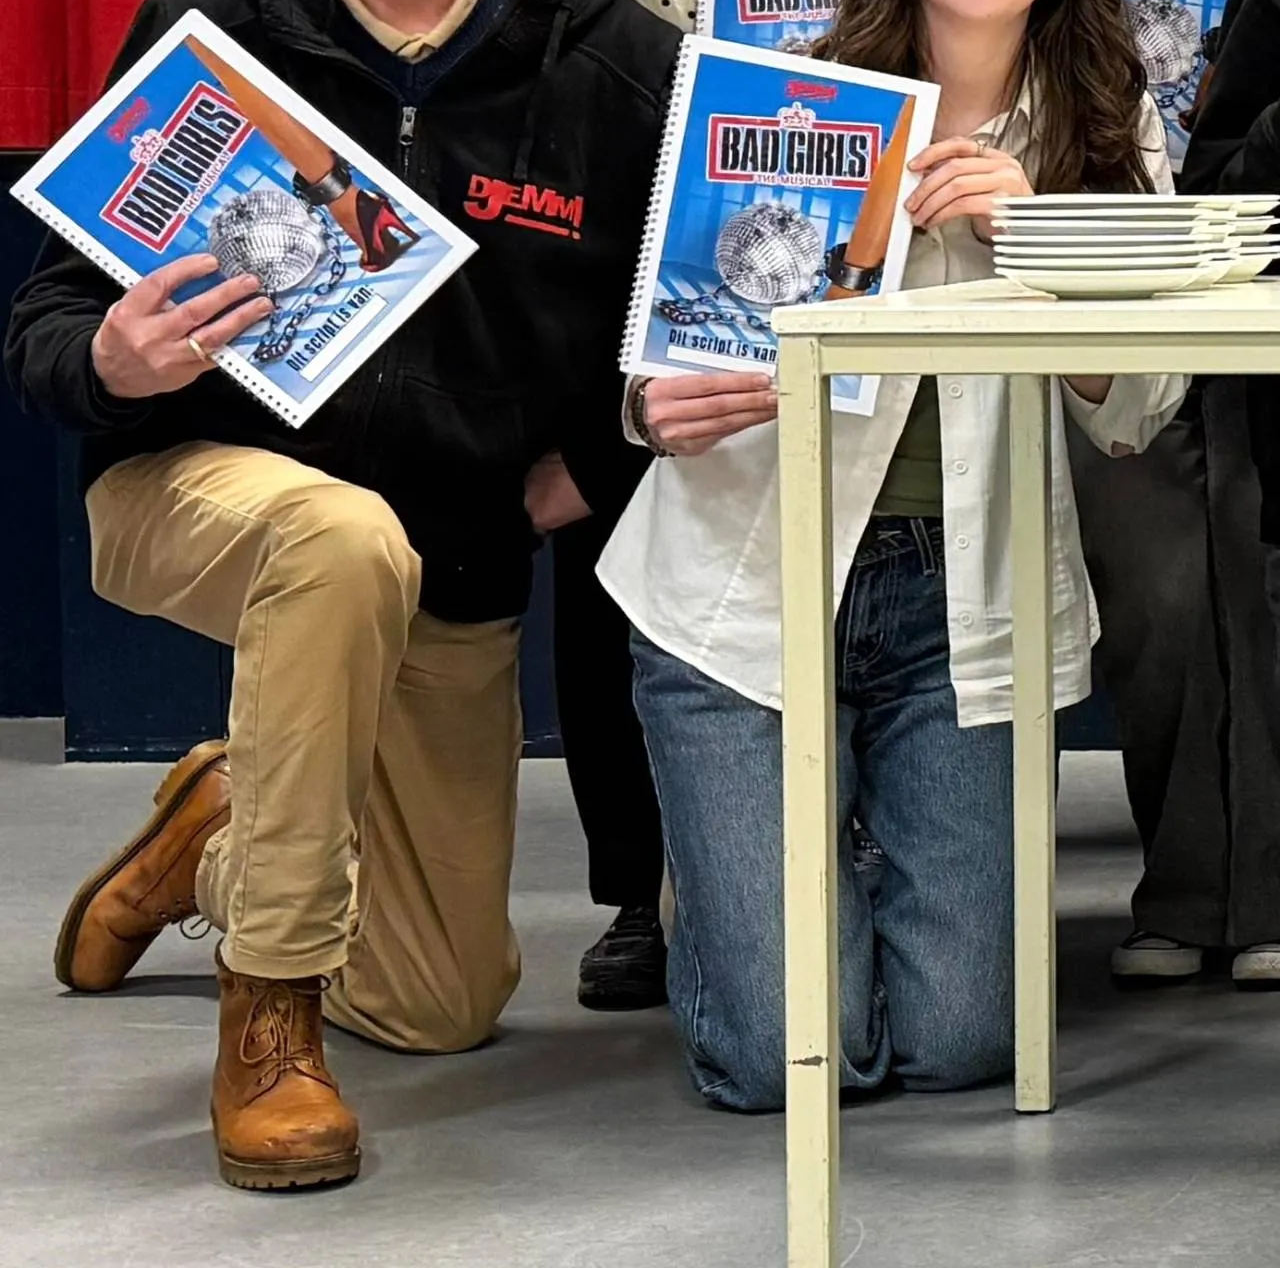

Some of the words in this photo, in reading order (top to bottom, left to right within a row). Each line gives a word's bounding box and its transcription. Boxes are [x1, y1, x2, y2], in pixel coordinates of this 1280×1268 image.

[118, 167, 190, 236] BAD
[157, 99, 241, 184] GIRLS
[720, 126, 780, 173] BAD
[787, 130, 868, 178] GIRLS
[286, 350, 308, 372] Dit
[304, 317, 340, 355] script
[334, 307, 352, 323] is
[669, 328, 687, 345] Dit
[692, 334, 732, 355] script
[735, 341, 749, 357] is
